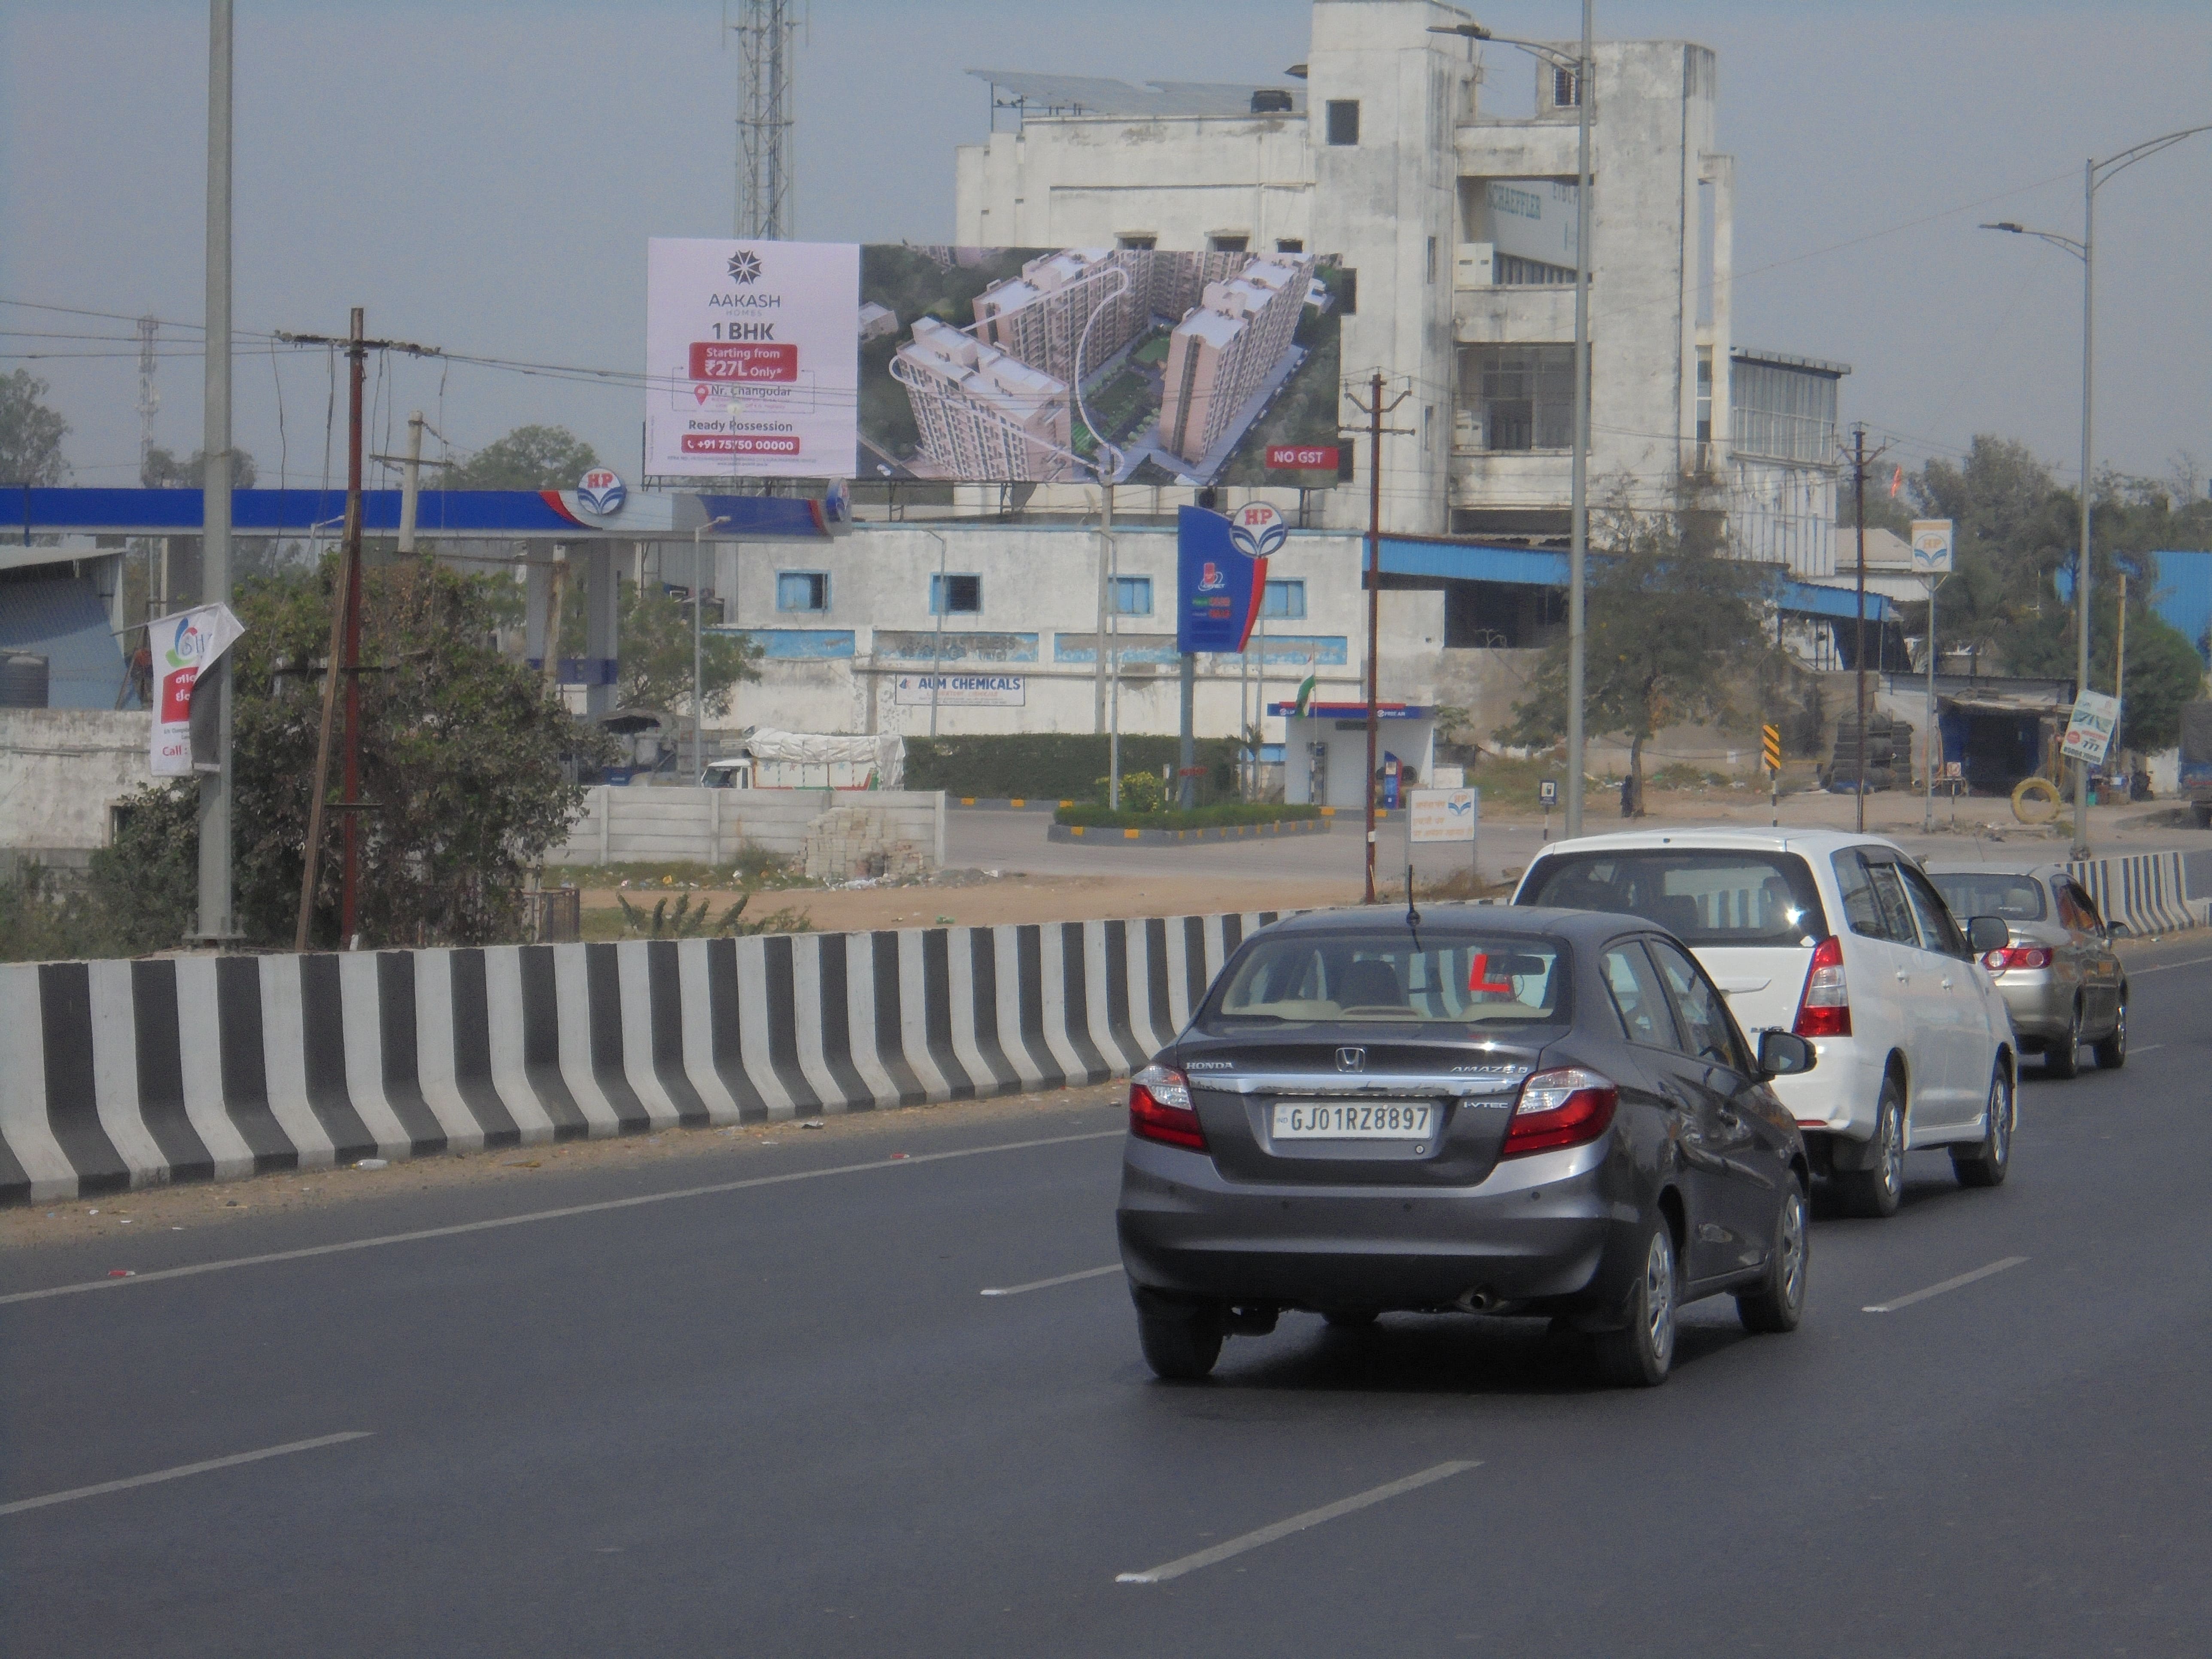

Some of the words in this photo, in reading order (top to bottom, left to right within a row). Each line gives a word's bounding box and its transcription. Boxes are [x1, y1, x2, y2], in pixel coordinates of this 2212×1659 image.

[708, 294, 781, 308] AAKASH
[712, 323, 721, 340] 1
[730, 323, 775, 340] BHK
[707, 347, 750, 360] Starting
[754, 348, 780, 359] from
[705, 360, 747, 377] ₹27L
[711, 386, 727, 395] Nr.
[731, 386, 792, 398] Changodar
[689, 420, 725, 432] Ready
[729, 420, 793, 432] Possession
[697, 440, 715, 449] +91
[755, 441, 793, 450] 00000
[1274, 451, 1294, 463] NO
[1298, 451, 1323, 464] GST
[588, 473, 613, 489] HP
[1245, 509, 1273, 526] HP
[918, 678, 947, 690] AUM
[951, 678, 1021, 690] CHEMICALS
[162, 746, 182, 756] Call
[1469, 954, 1510, 993] L
[1450, 1064, 1516, 1074] AMAZE
[1291, 1107, 1429, 1131] GJ01RZ8897
